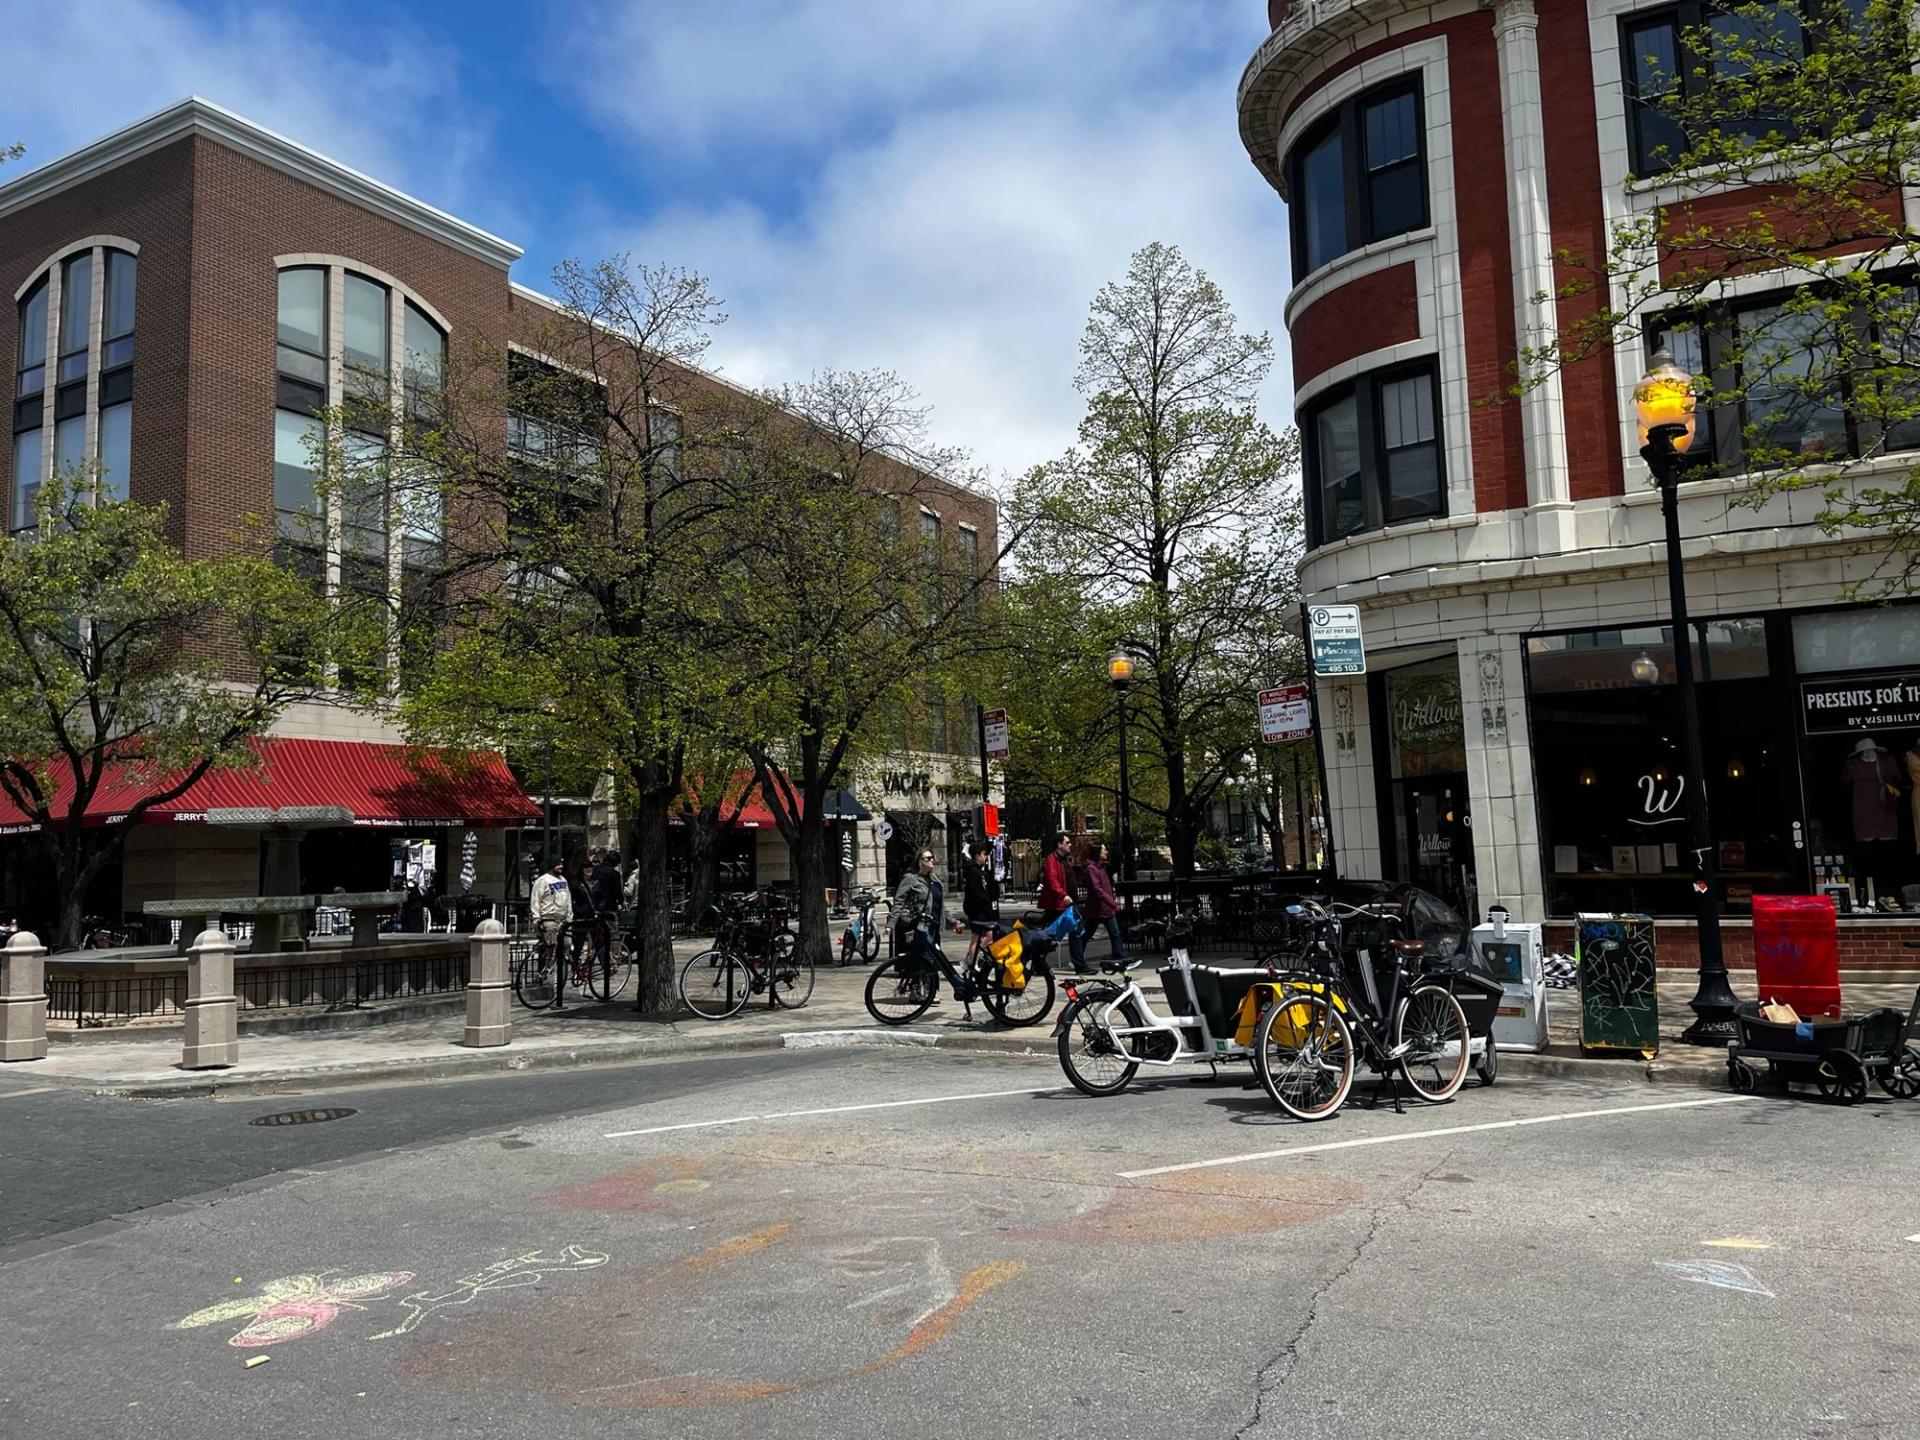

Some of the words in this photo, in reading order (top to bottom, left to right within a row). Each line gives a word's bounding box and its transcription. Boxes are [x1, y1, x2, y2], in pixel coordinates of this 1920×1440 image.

[1262, 696, 1287, 705] STANDING
[1806, 689, 1873, 709] PRESENTS
[1876, 687, 1903, 705] FOR
[1264, 711, 1287, 720] FLASHING
[1289, 708, 1307, 716] LIGHTS
[1396, 695, 1462, 730] Willow
[1848, 717, 1861, 726] BY
[1865, 712, 1920, 724] VISIBILITY
[1267, 733, 1283, 741] TOW
[1287, 730, 1308, 739] ZONE
[1637, 775, 1685, 813] W
[173, 813, 208, 821] JERRY'S
[372, 818, 408, 827] Sandwiches
[414, 819, 433, 827] Salads
[434, 819, 450, 827] Since
[1418, 833, 1452, 852] Willow
